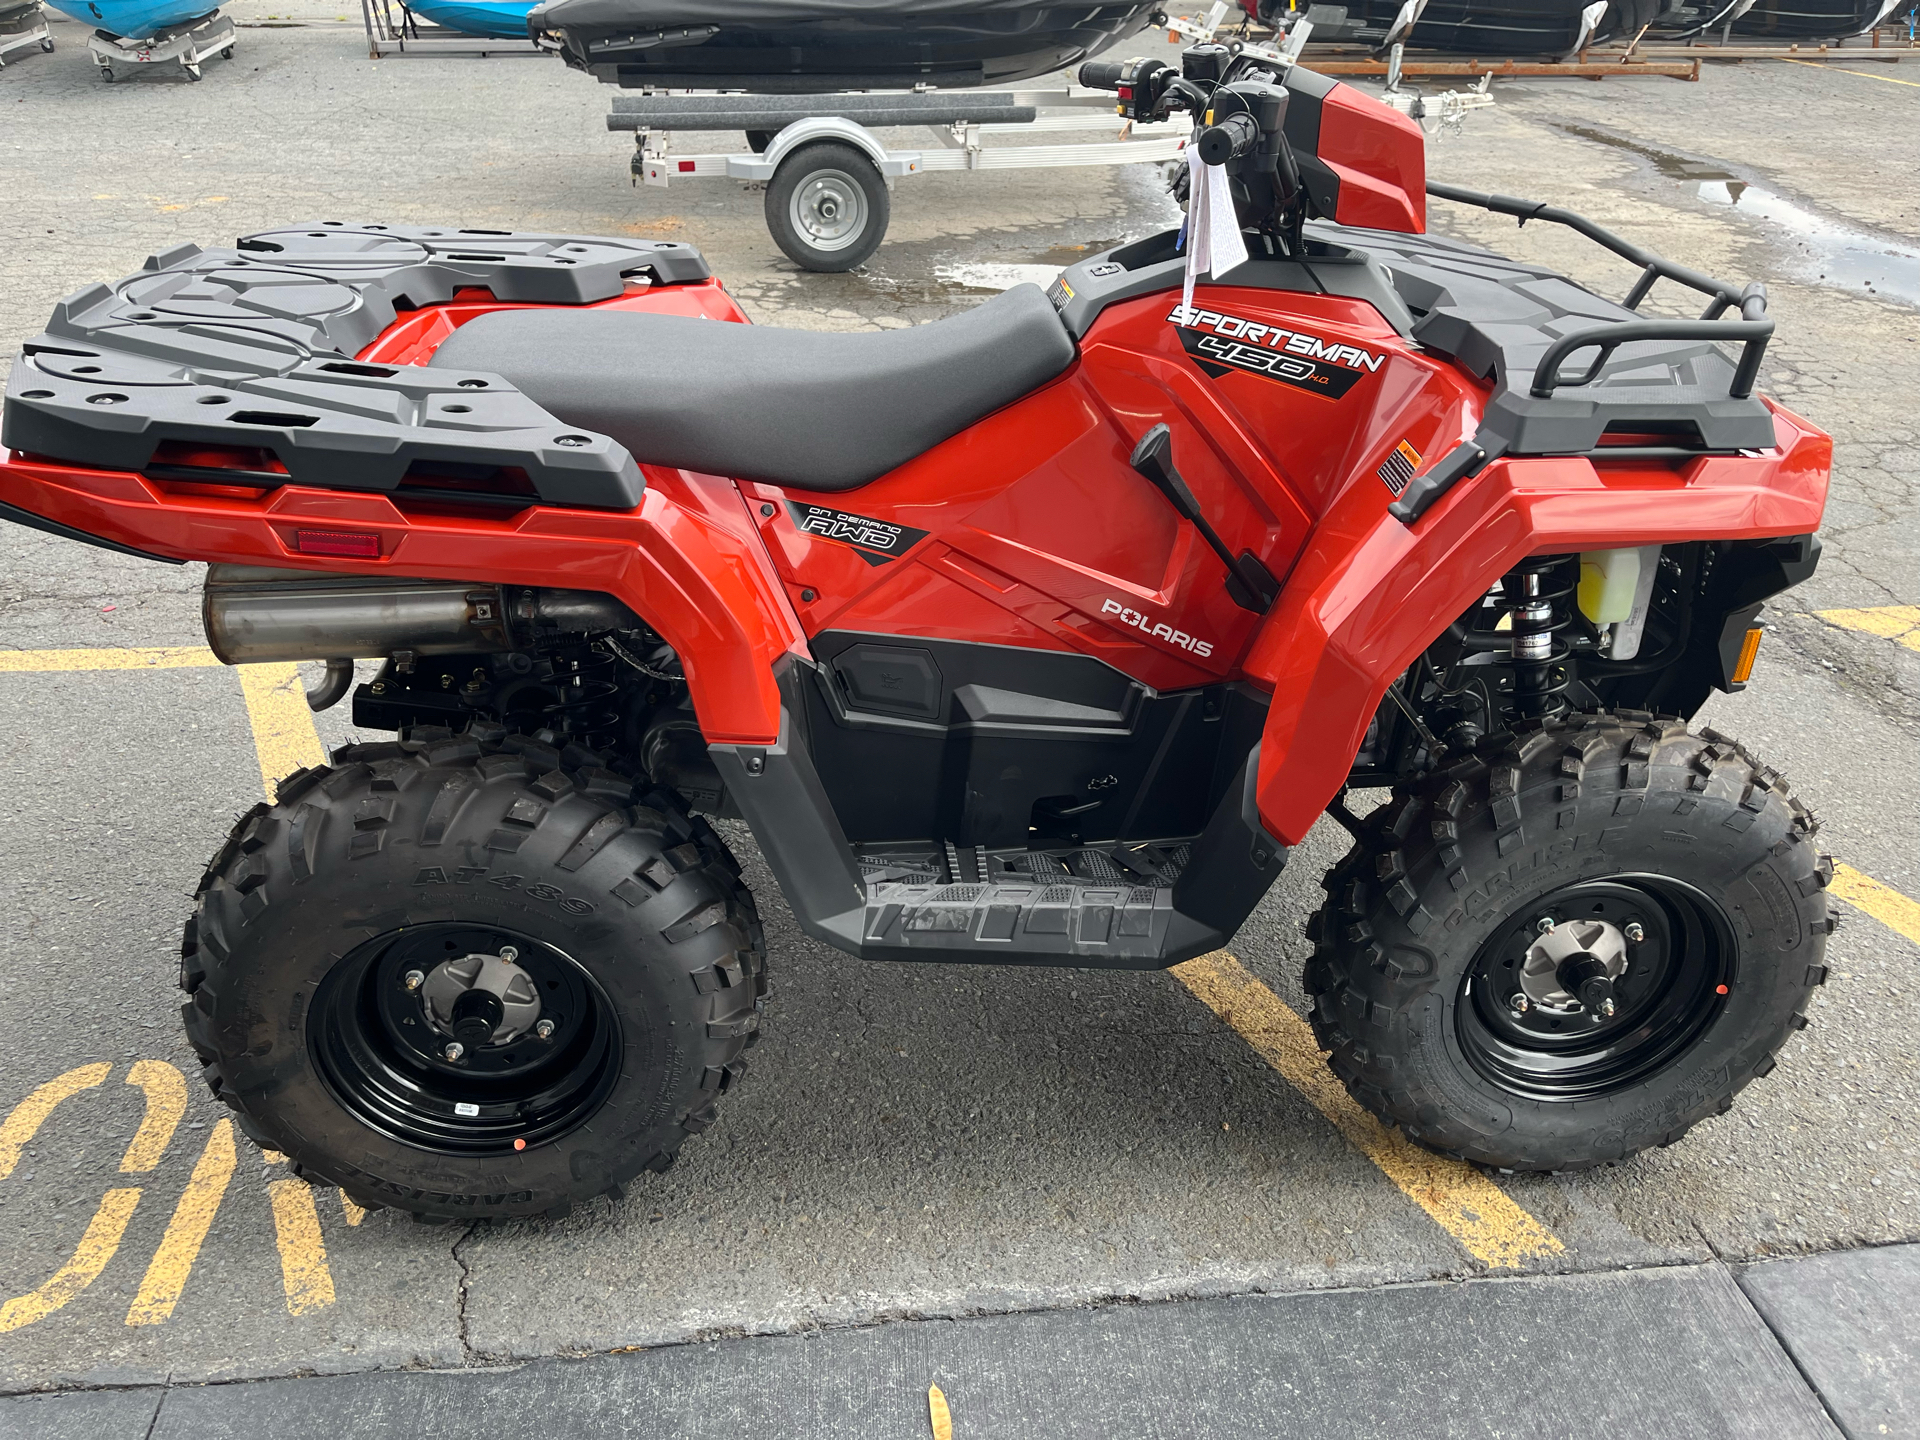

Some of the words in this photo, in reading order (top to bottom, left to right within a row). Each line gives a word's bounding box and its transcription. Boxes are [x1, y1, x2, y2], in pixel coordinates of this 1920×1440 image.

[1166, 304, 1387, 373] SPORTSMAN
[1197, 335, 1316, 381] 450
[800, 515, 897, 549] AWD
[808, 507, 832, 517] ON
[836, 513, 902, 534] DEMAND
[1101, 598, 1214, 658] POLARIS
[411, 865, 596, 917] AT489
[1443, 825, 1629, 933] CARLISLE
[1593, 1065, 1731, 1148] AT489
[333, 1159, 535, 1207] CARLISLE
